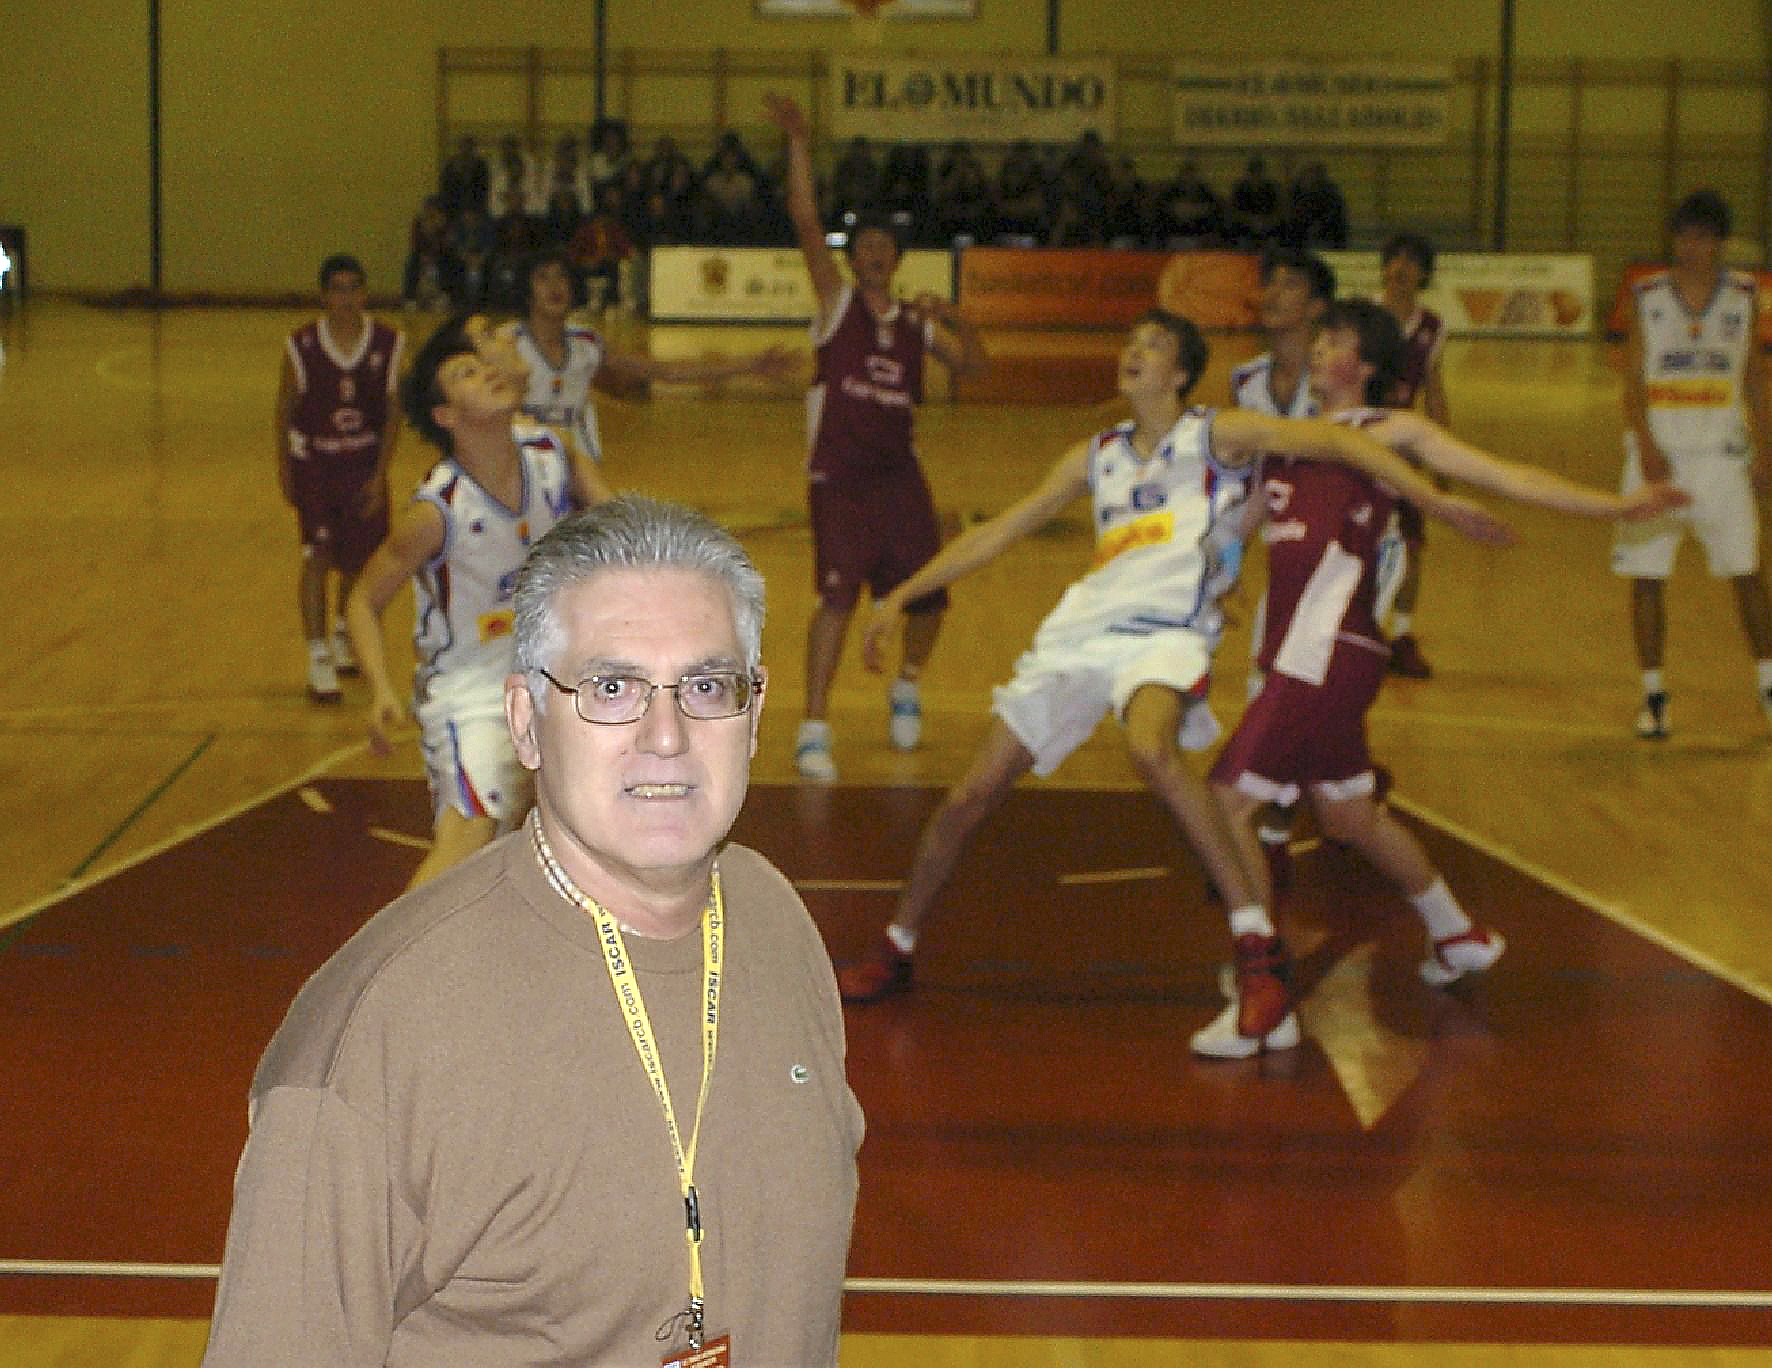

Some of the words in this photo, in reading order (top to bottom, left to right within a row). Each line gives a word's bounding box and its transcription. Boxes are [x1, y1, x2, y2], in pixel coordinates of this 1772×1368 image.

[943, 71, 1105, 109] MUNDO
[601, 921, 627, 976] ISCAR
[707, 971, 720, 1024] ISCAR
